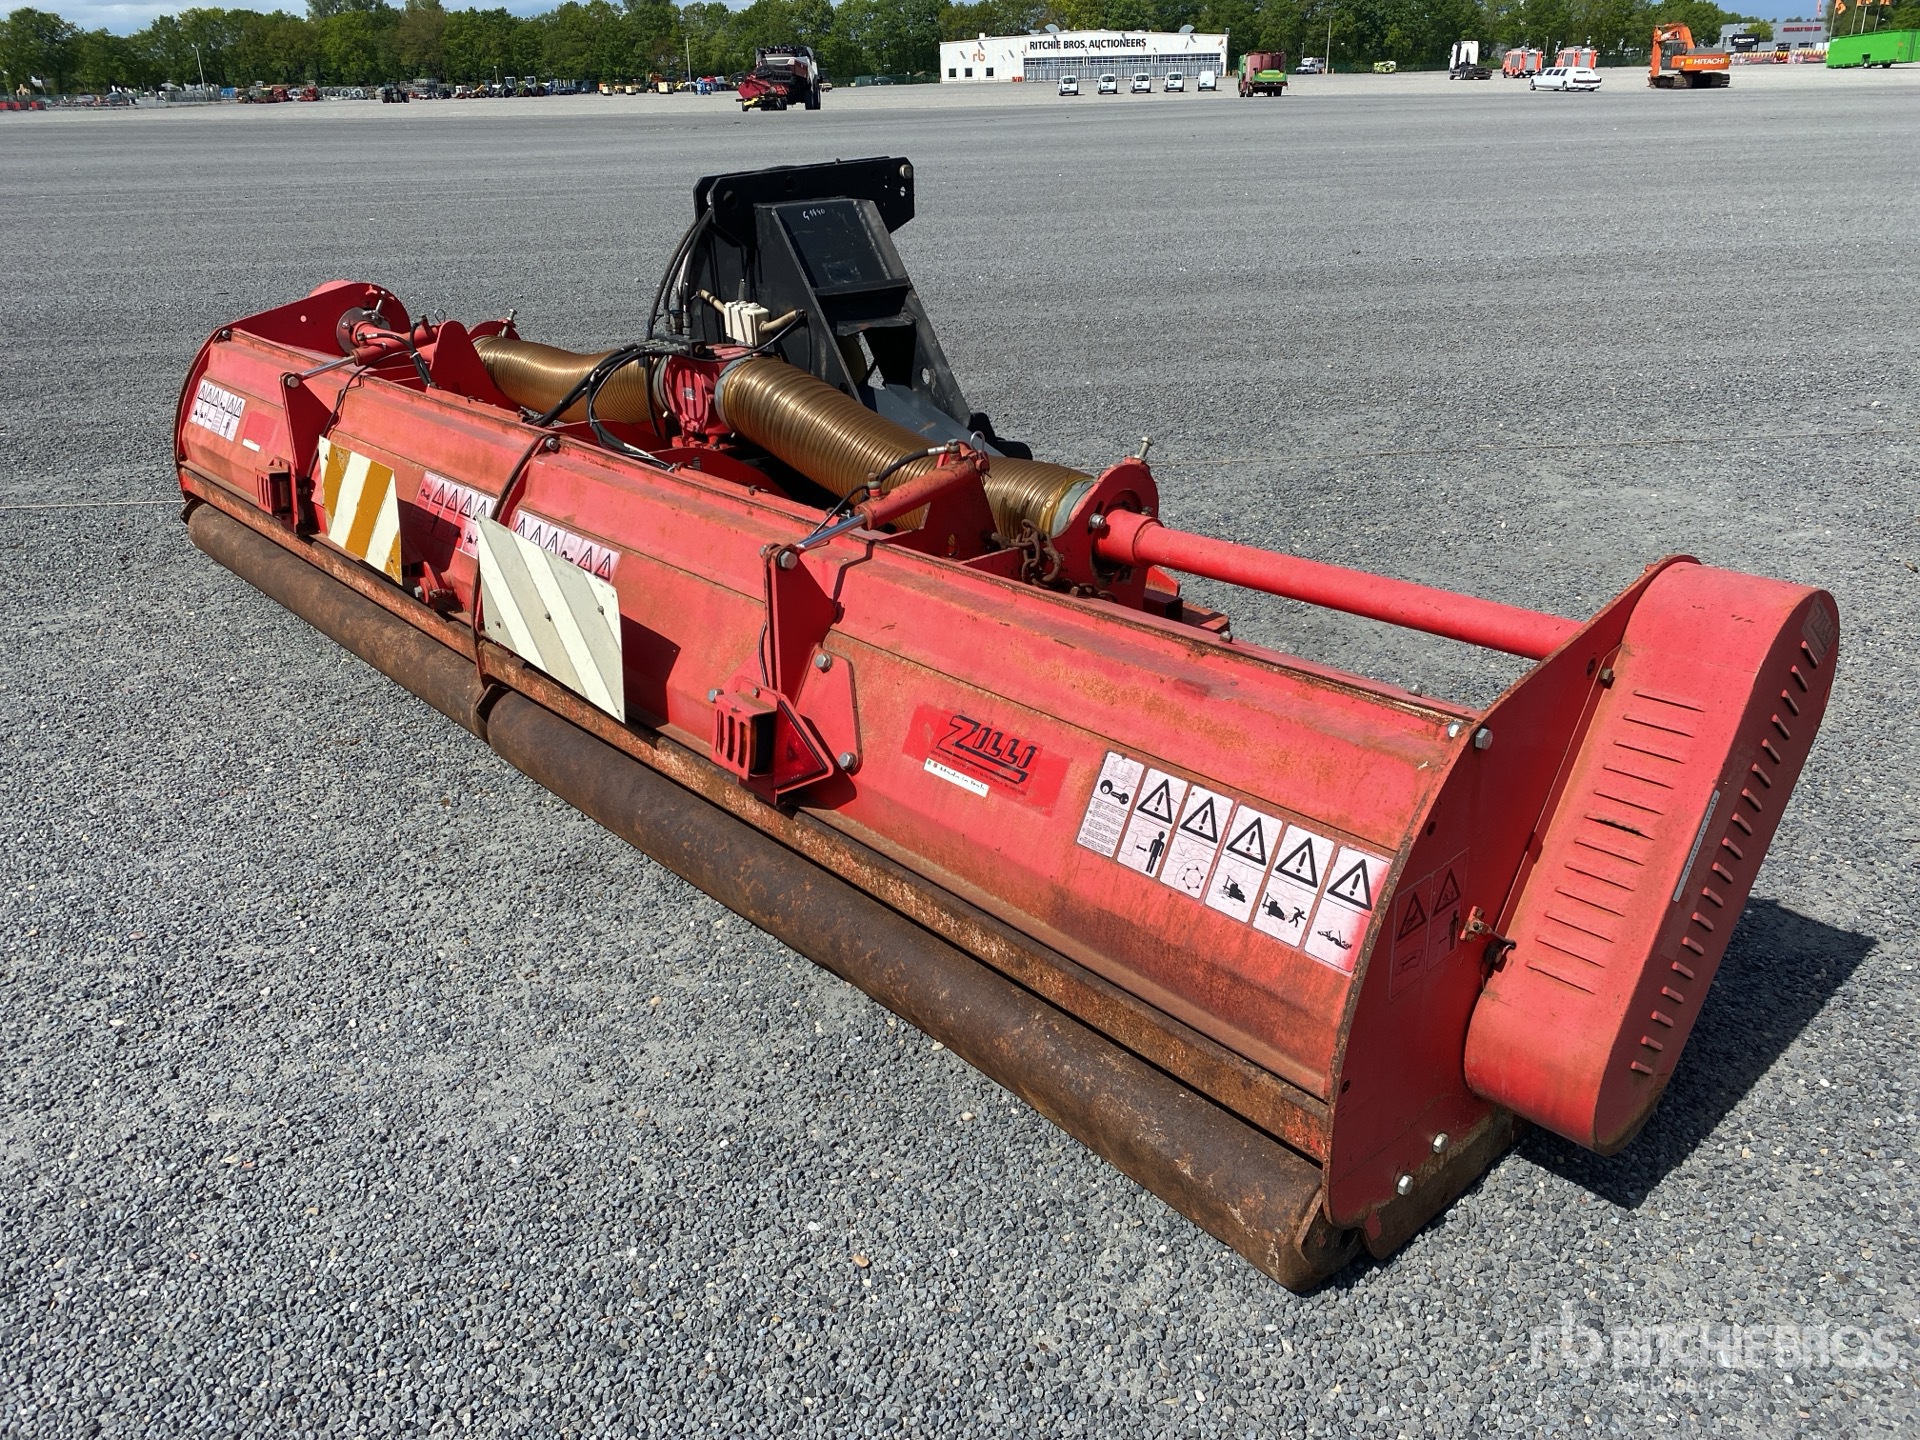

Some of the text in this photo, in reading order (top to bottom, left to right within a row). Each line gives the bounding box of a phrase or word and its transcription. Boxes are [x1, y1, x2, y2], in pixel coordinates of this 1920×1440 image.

[1029, 38, 1147, 50] RITCHIE BROS. AUCTIONEERS
[972, 48, 986, 62] rb
[1693, 57, 1726, 65] HITACHI
[936, 714, 1038, 784] ZILLI
